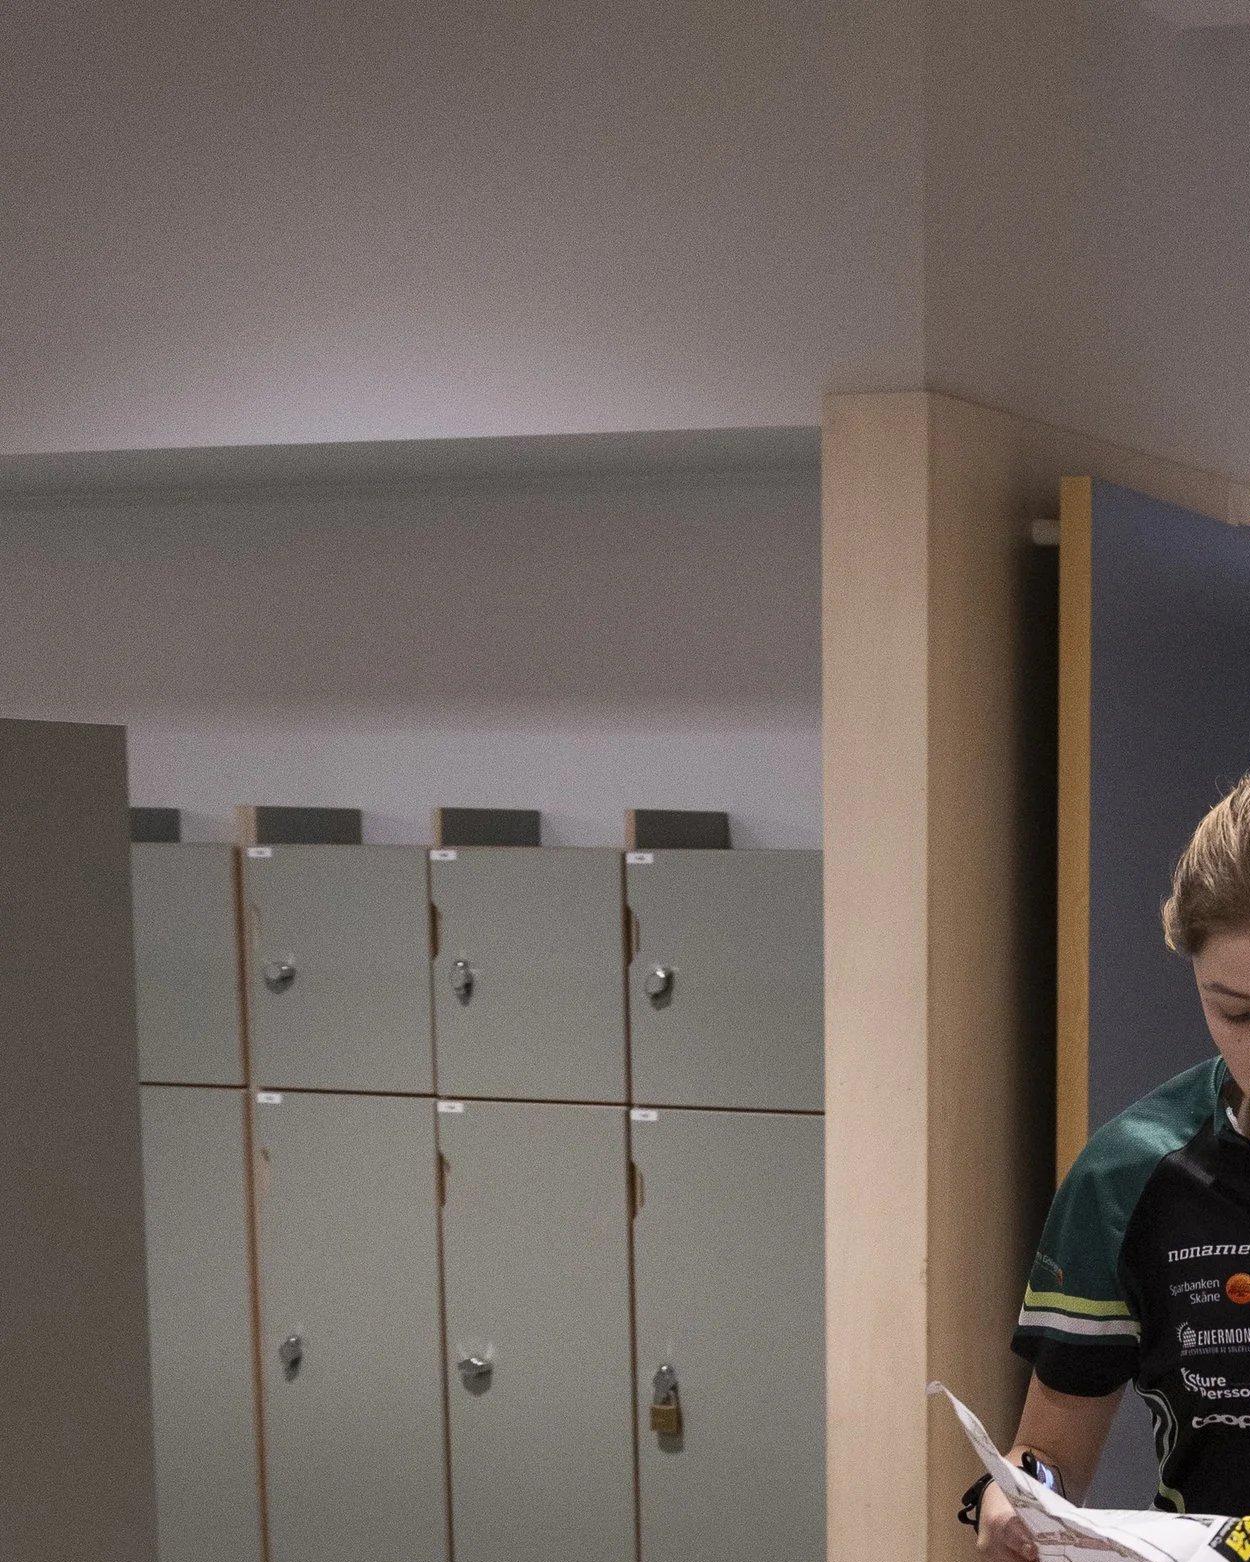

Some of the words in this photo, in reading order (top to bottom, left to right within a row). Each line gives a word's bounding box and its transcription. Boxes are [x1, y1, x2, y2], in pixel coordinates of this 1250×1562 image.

[1168, 1244, 1250, 1262] noname
[1169, 1278, 1220, 1296] Sparbanken
[1189, 1290, 1221, 1304] Skåne
